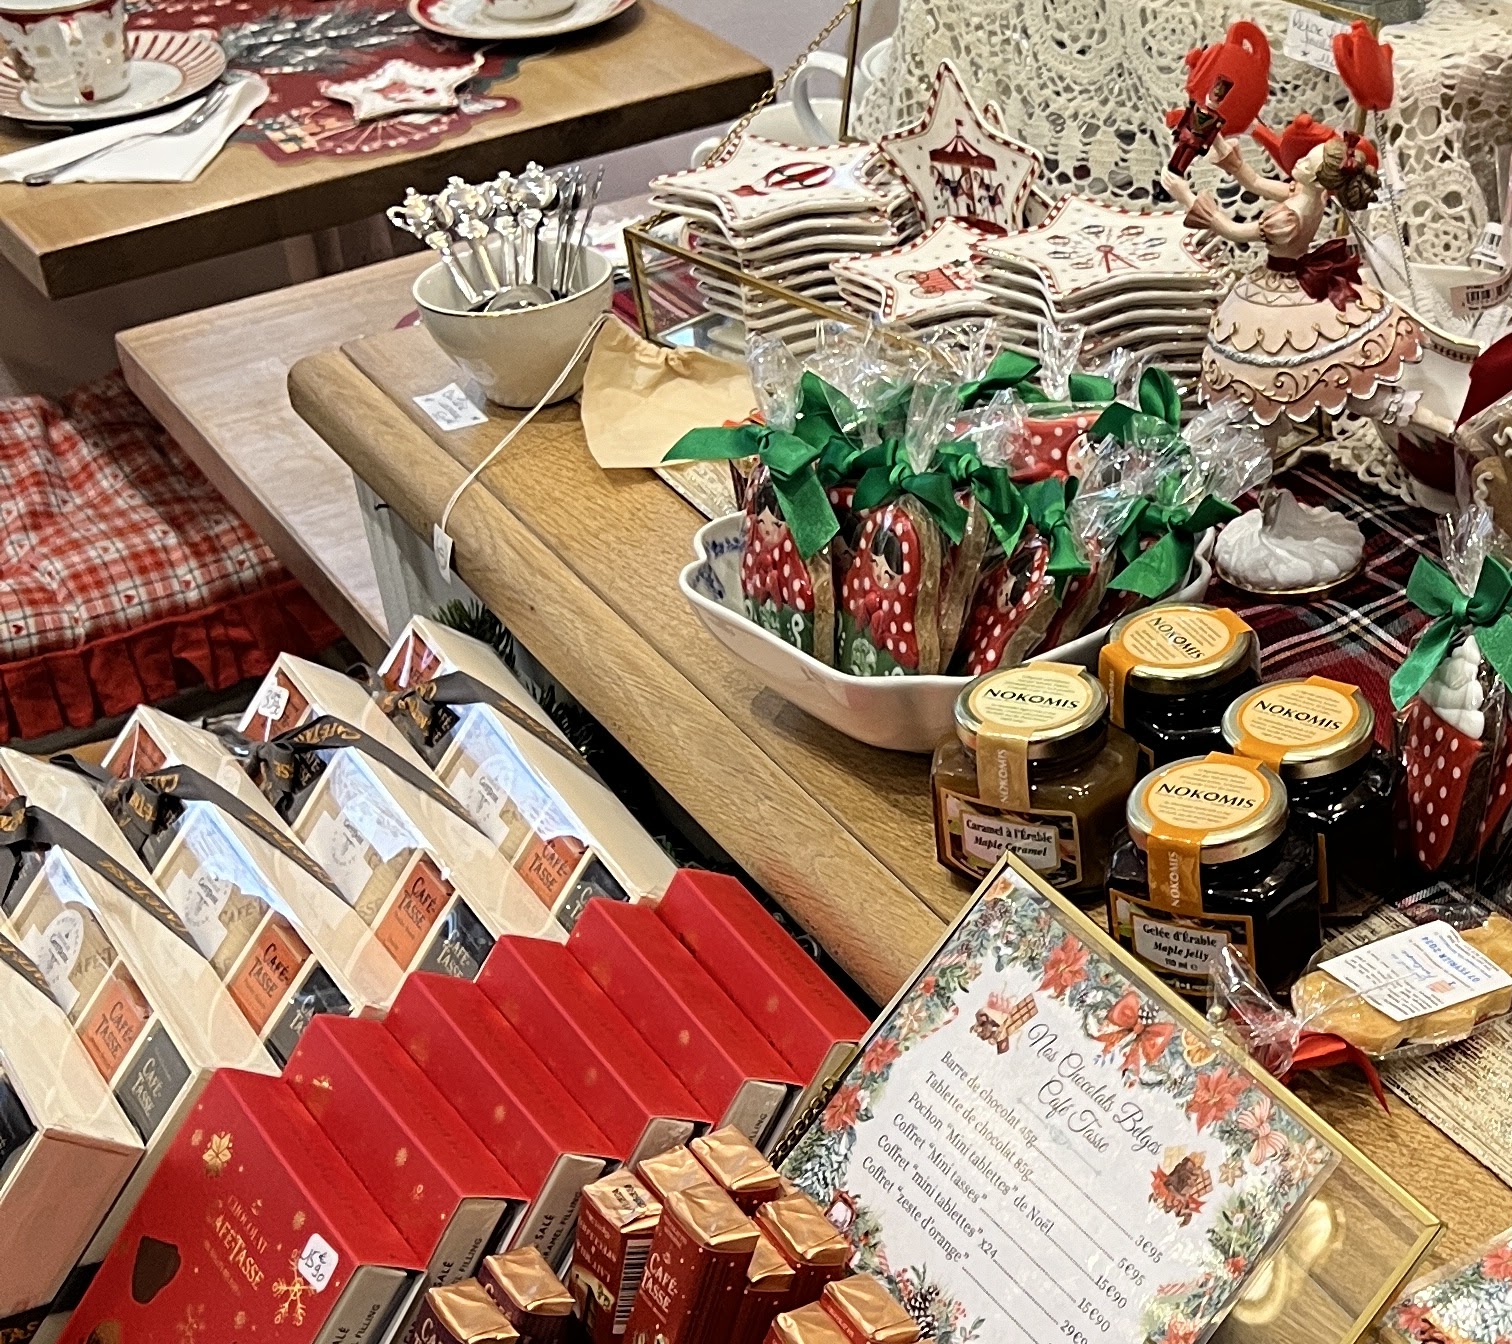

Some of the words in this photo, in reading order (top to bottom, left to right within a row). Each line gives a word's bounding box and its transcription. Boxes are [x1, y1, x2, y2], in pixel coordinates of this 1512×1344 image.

[1149, 616, 1206, 660] NOKOMIS
[985, 688, 1081, 711] NOKOMIS
[1255, 700, 1344, 732] NOKOMIS
[1157, 783, 1257, 810] NOKOMIS
[966, 819, 1003, 839] Caramel
[1006, 826, 1014, 838] à
[1014, 824, 1053, 844] l'Érable
[974, 836, 1003, 853] Maple
[1005, 840, 1048, 857] Caramel
[528, 855, 558, 892] TASSE
[400, 896, 427, 931] TASSE
[1143, 923, 1170, 940] Gelée
[1173, 926, 1217, 949] d'Érable
[1154, 941, 1183, 958] Maple
[248, 958, 276, 999] TASSE
[94, 1017, 121, 1057] TASSE
[1026, 1022, 1060, 1062] Nos
[1056, 1052, 1118, 1113] Chocolats
[1111, 1101, 1164, 1157] Belges
[1035, 1078, 1075, 1120] Café
[1066, 1108, 1111, 1153] Tasse
[861, 1156, 895, 1191] Coffret
[940, 1051, 968, 1080] Barre
[966, 1075, 981, 1092] de
[978, 1088, 1021, 1129] chocolat
[1134, 1235, 1163, 1263] 3€95
[877, 1134, 910, 1171] Coffret
[977, 1238, 998, 1259] x24
[924, 1070, 964, 1111] Tablette
[961, 1107, 976, 1124] de
[974, 1120, 1016, 1162] chocolat
[1012, 1157, 1034, 1181] 85g
[1117, 1257, 1145, 1286] 5€95
[907, 1092, 944, 1130] Pochon
[1013, 1194, 1028, 1212] de
[1025, 1205, 1055, 1235] Noël
[1094, 1275, 1128, 1309] 15€90
[892, 1113, 926, 1149] Coffret
[1077, 1297, 1111, 1332] 15€90
[641, 1266, 672, 1314] TASSE
[354, 1304, 381, 1339] FILLING
